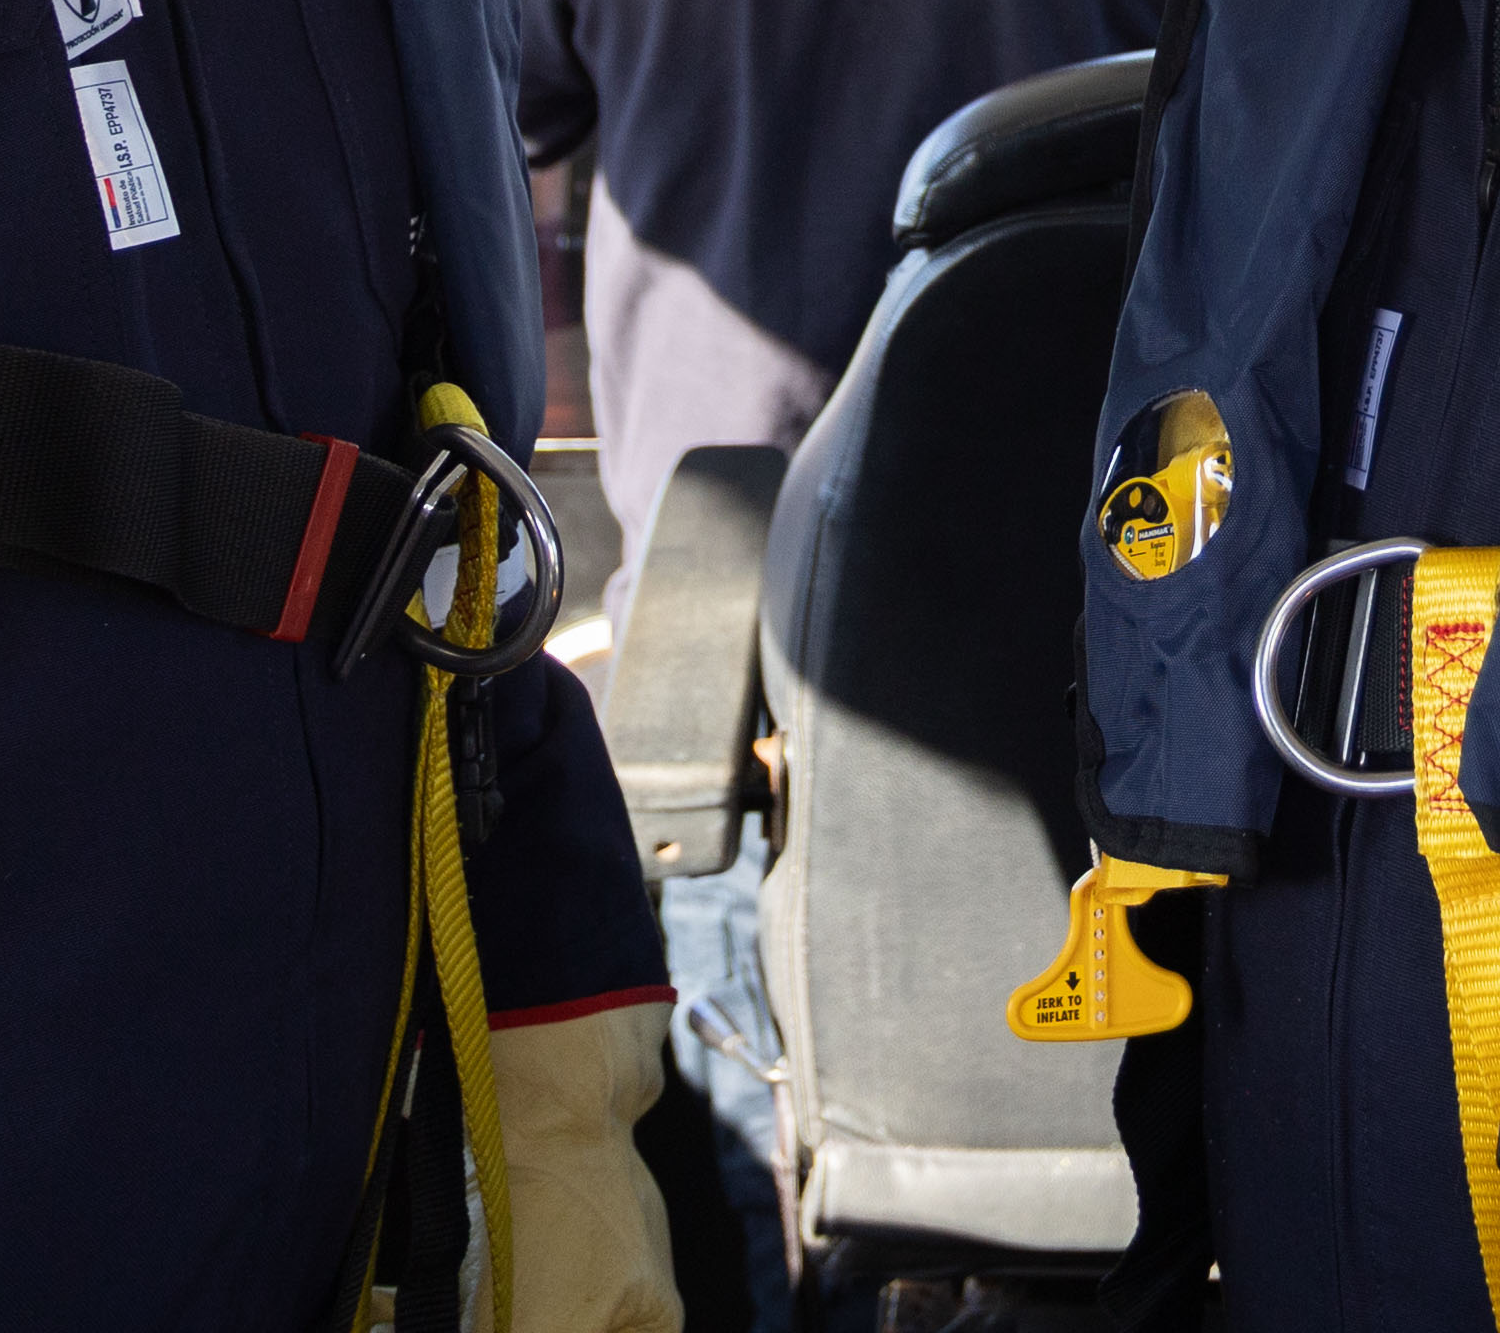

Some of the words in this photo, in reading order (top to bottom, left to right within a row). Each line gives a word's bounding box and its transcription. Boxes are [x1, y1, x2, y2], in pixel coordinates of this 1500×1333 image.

[98, 87, 123, 135] EPP4737
[114, 139, 133, 168] I.S.P.
[118, 179, 126, 189] de
[126, 171, 138, 200] Pública
[122, 190, 135, 225] Instituto
[132, 201, 143, 223] Salud
[1036, 996, 1063, 1009] JERK
[1068, 995, 1082, 1006] TO
[1037, 1009, 1080, 1023] INFLATE
